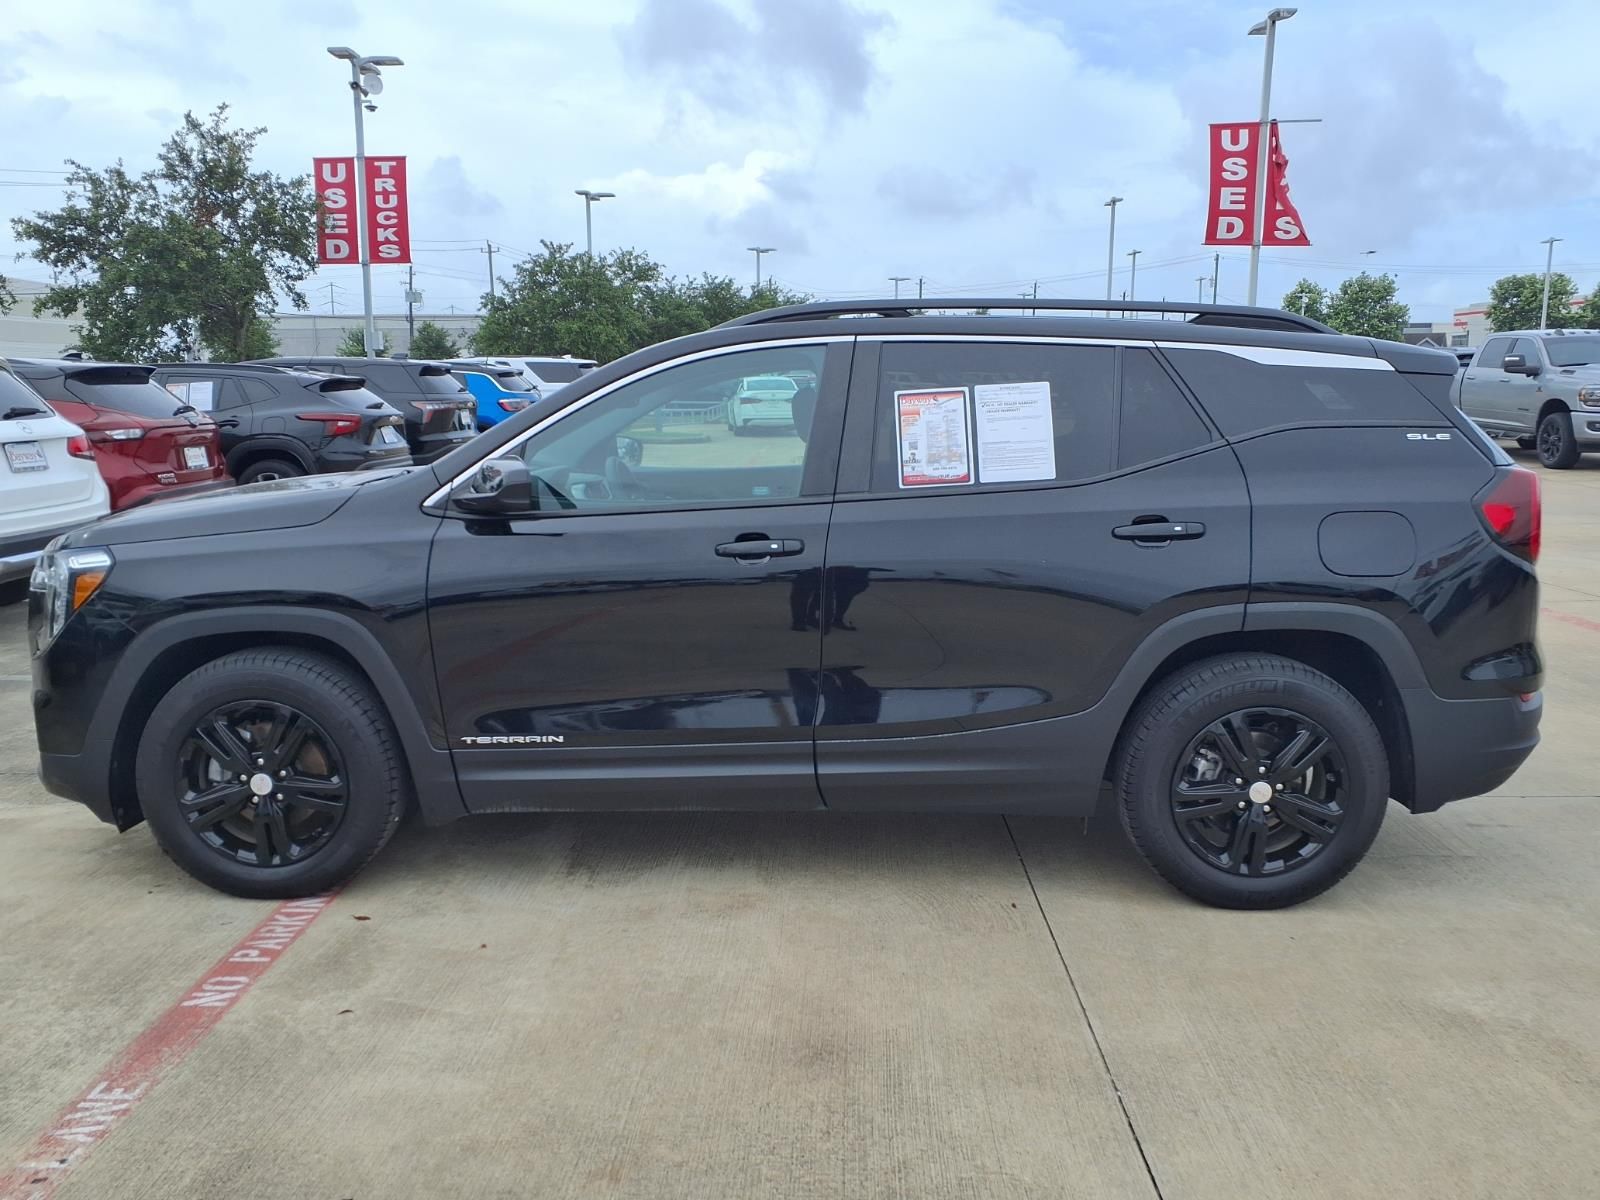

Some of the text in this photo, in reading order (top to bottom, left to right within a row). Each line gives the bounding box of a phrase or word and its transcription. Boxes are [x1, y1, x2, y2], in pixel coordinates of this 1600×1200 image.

[322, 163, 349, 259] USED
[374, 161, 401, 258] TRUCKS
[1216, 128, 1249, 239] USED
[461, 735, 564, 744] TERRAIN
[180, 975, 250, 1007] NO
[228, 893, 332, 962] PARKIN
